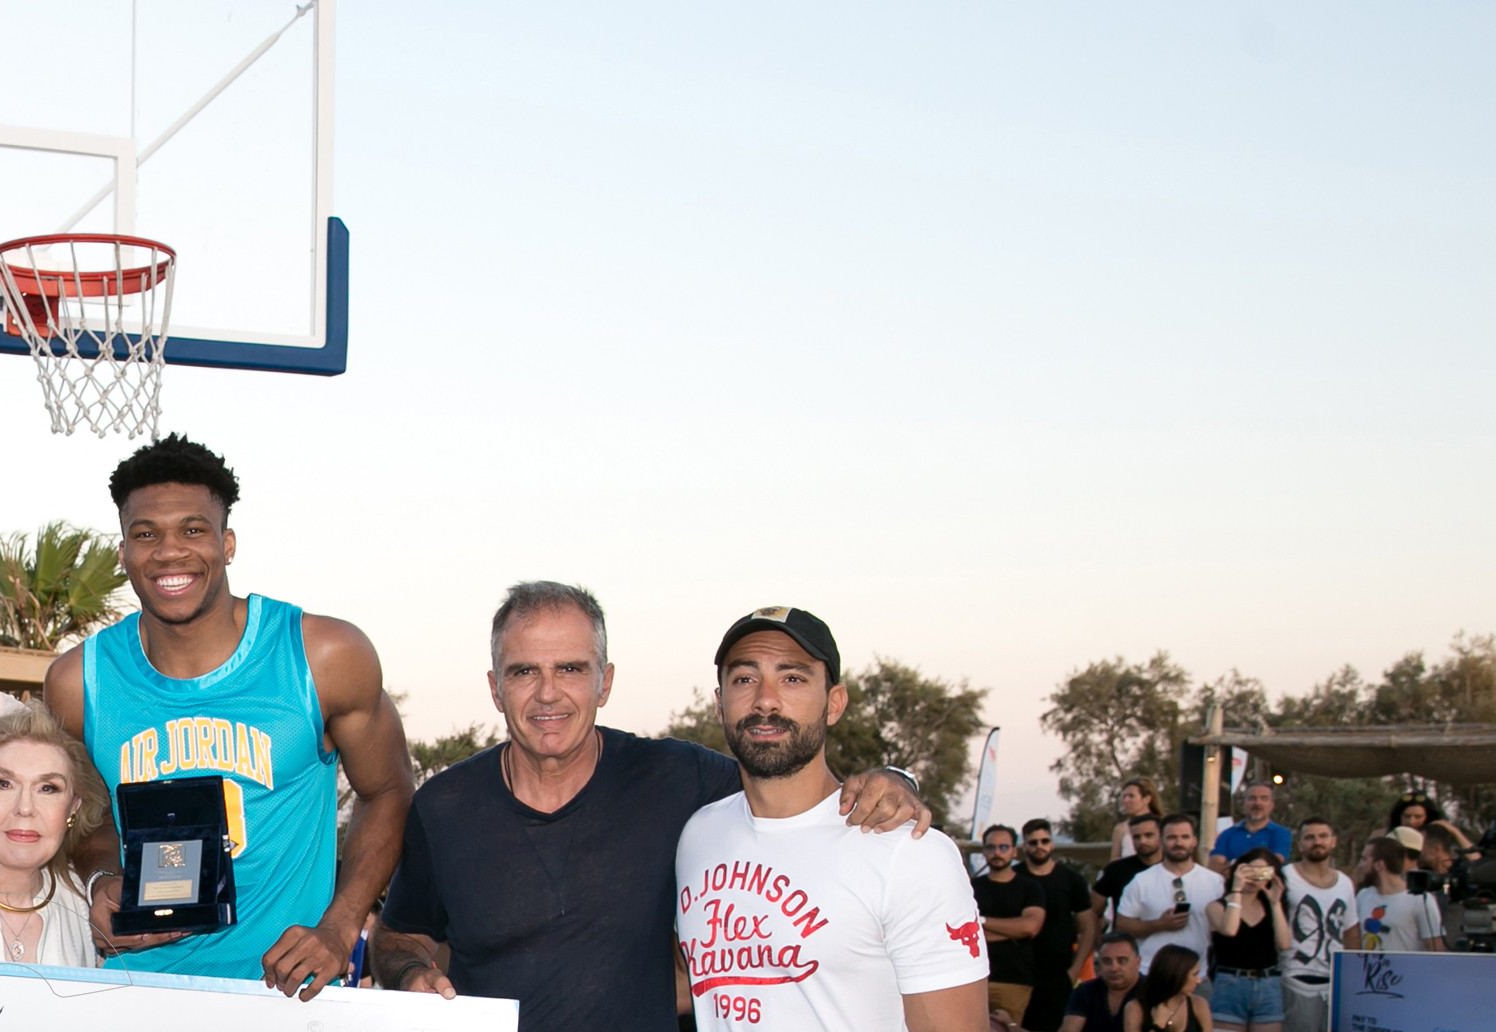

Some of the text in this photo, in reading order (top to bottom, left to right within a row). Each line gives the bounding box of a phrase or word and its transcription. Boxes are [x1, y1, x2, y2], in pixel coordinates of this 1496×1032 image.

[120, 716, 274, 791] AIR JORDAN
[700, 860, 829, 939] JOHNSON
[700, 898, 772, 948] Flex
[679, 937, 819, 978] Kavana
[712, 992, 762, 1025] 1996
